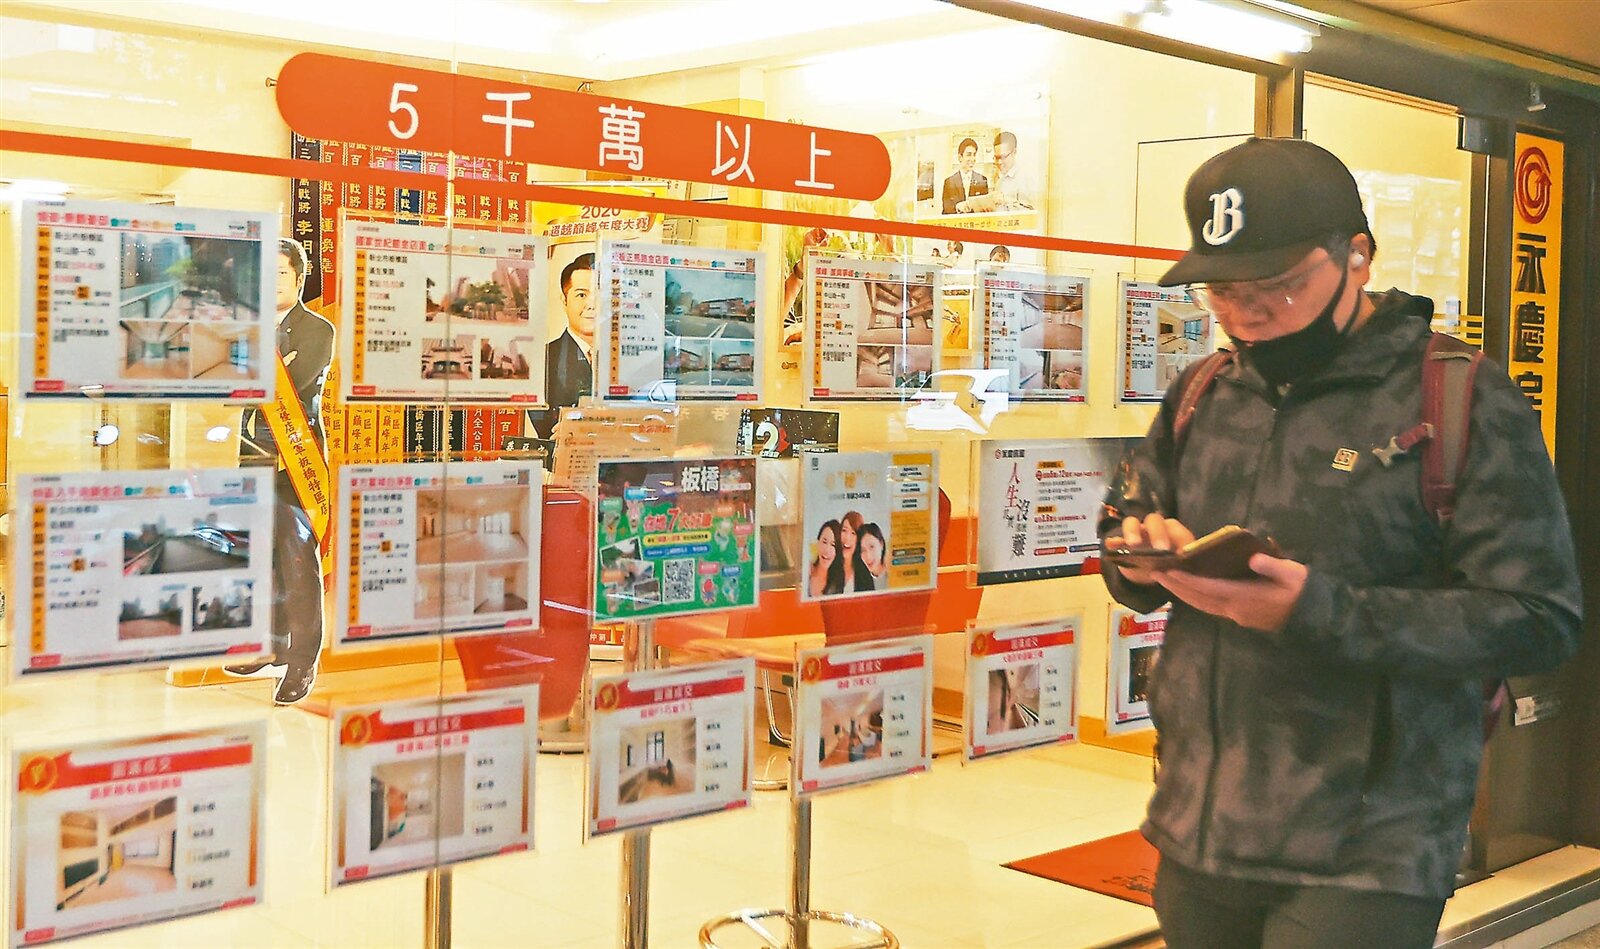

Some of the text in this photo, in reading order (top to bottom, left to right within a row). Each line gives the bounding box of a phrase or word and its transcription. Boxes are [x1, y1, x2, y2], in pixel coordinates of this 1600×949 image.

[387, 83, 836, 192] 5千萬以上
[1202, 187, 1244, 246] B
[681, 466, 721, 493] 板橋
